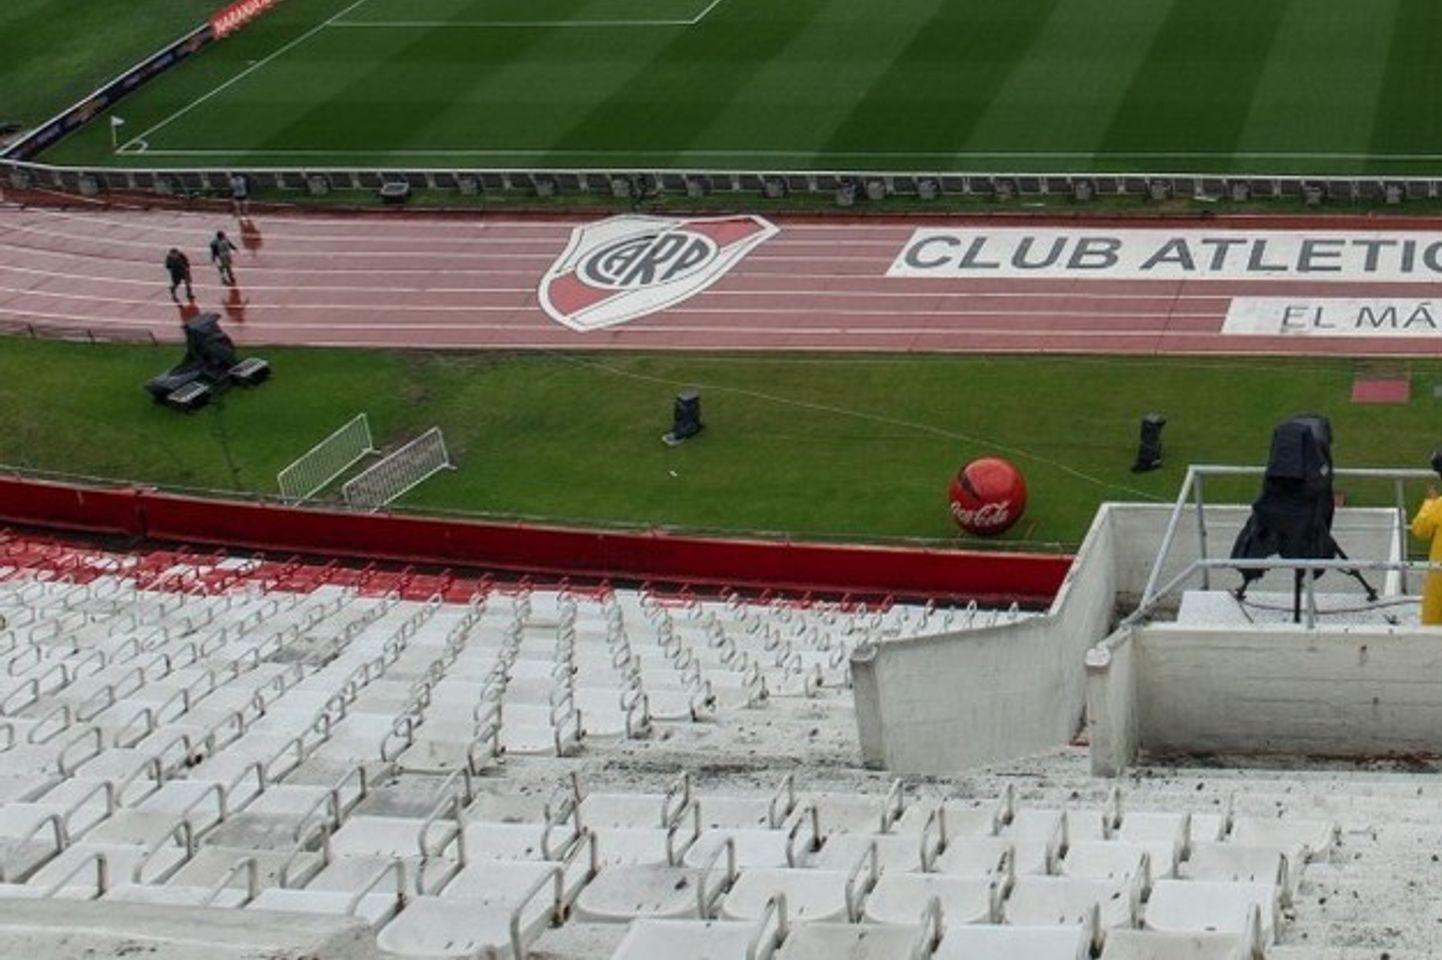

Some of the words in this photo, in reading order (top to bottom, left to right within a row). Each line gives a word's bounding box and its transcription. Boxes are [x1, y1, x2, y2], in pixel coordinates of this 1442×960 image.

[586, 231, 711, 286] CARP
[903, 234, 1121, 270] CLUB
[1281, 305, 1337, 330] EL
